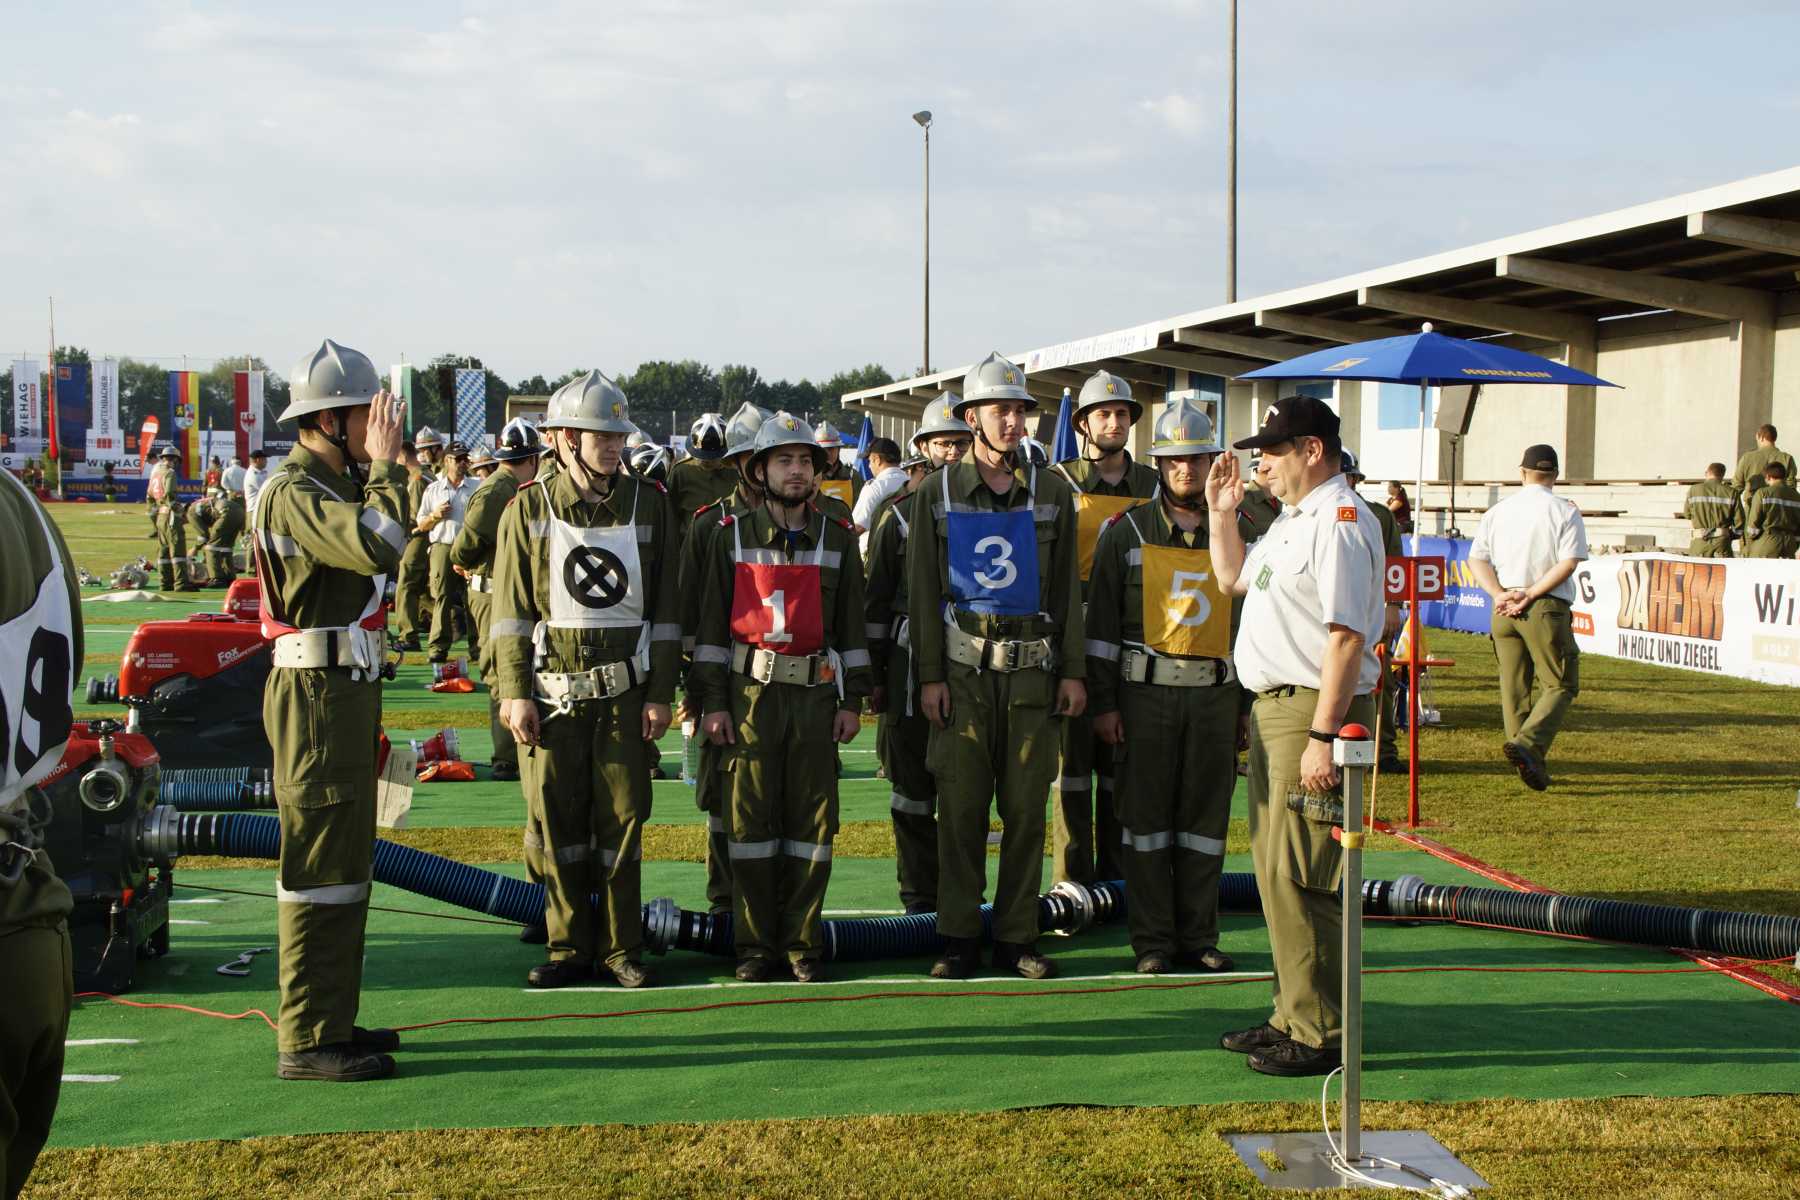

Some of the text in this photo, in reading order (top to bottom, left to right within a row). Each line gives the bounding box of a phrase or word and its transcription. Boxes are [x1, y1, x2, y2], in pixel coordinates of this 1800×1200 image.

[974, 535, 1018, 589] 3
[1387, 564, 1441, 594] 9 B
[761, 590, 793, 642] 1
[1167, 569, 1212, 626] 5
[1617, 560, 1726, 641] DAHEIM
[1618, 633, 1722, 671] IN HOLZ UND ZIEGEL.
